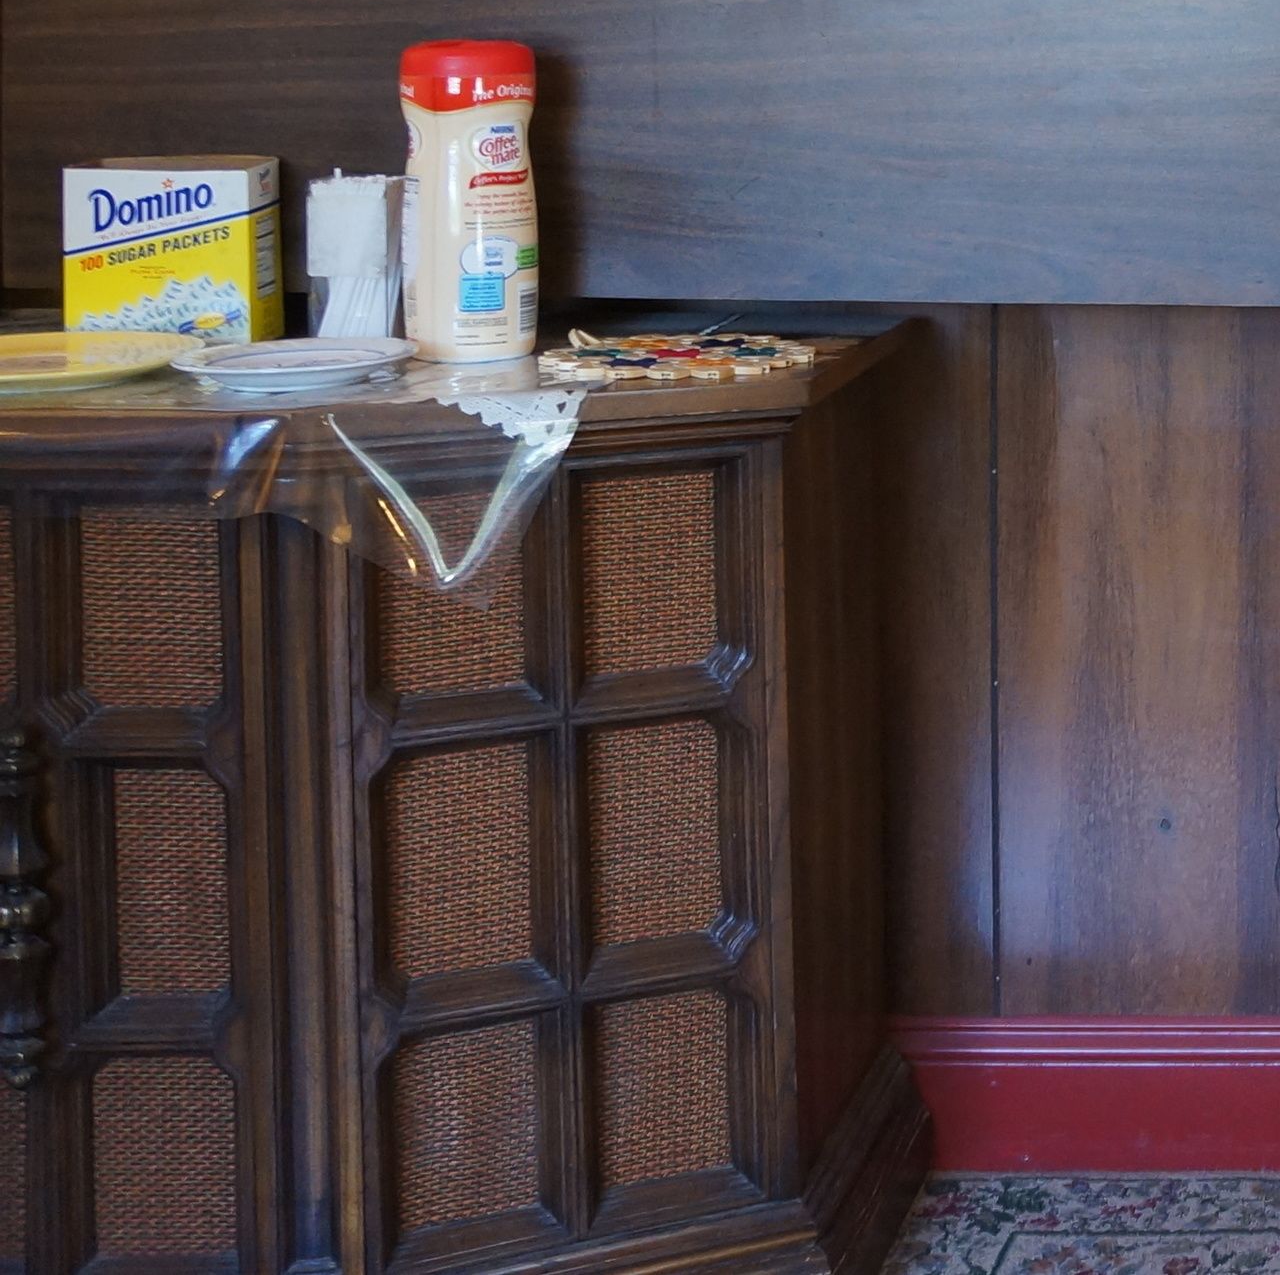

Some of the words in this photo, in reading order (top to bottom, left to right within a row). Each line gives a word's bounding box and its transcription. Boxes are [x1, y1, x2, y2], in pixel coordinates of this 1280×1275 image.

[88, 183, 214, 233] Domino
[80, 254, 104, 272] 100
[107, 243, 157, 266] SUGAR
[162, 226, 231, 254] PACKETS
